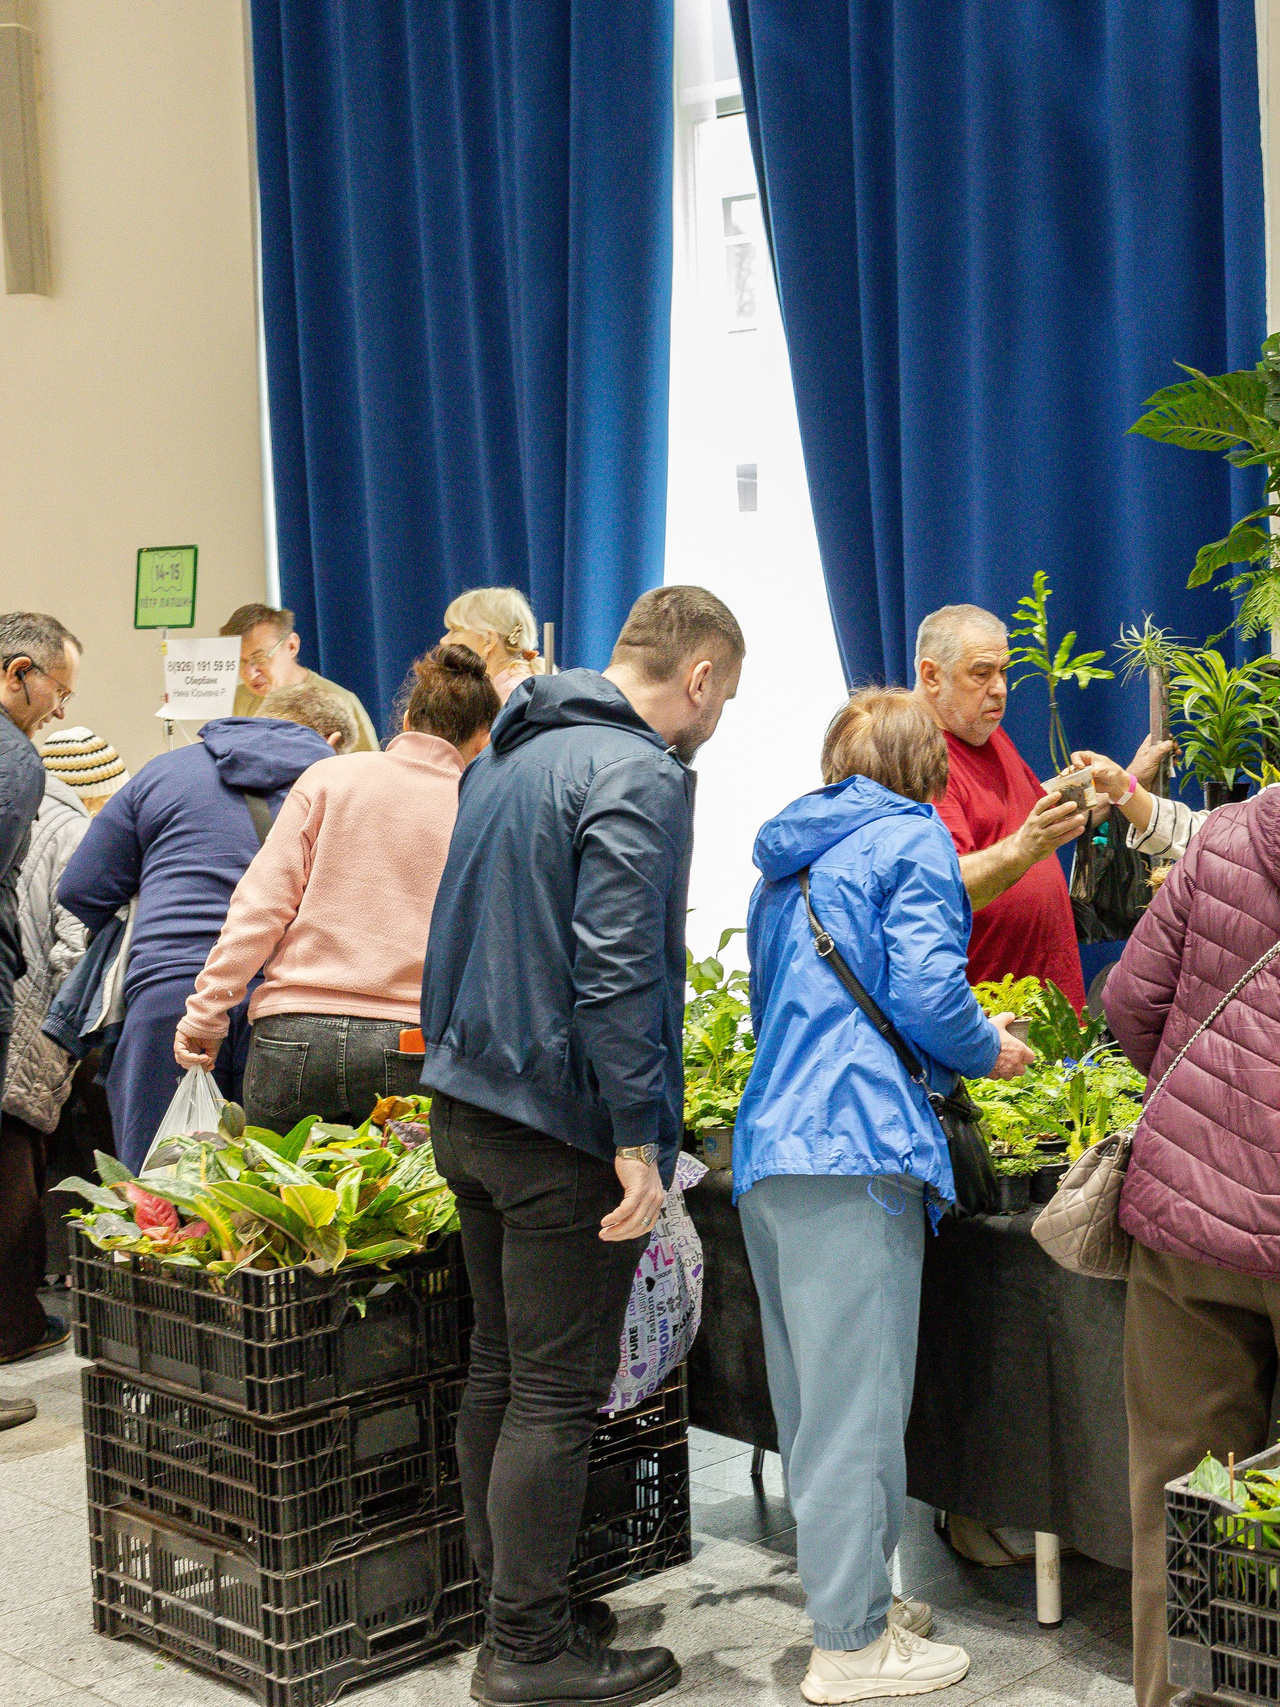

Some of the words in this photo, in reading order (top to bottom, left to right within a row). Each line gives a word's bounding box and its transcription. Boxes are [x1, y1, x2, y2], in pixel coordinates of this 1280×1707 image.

[184, 676, 218, 686] Сбербанк
[197, 660, 211, 672] 191
[213, 660, 224, 671] 59
[636, 1280, 648, 1313] stylish
[646, 1296, 657, 1344] Fashion
[629, 1325, 639, 1361] PURE
